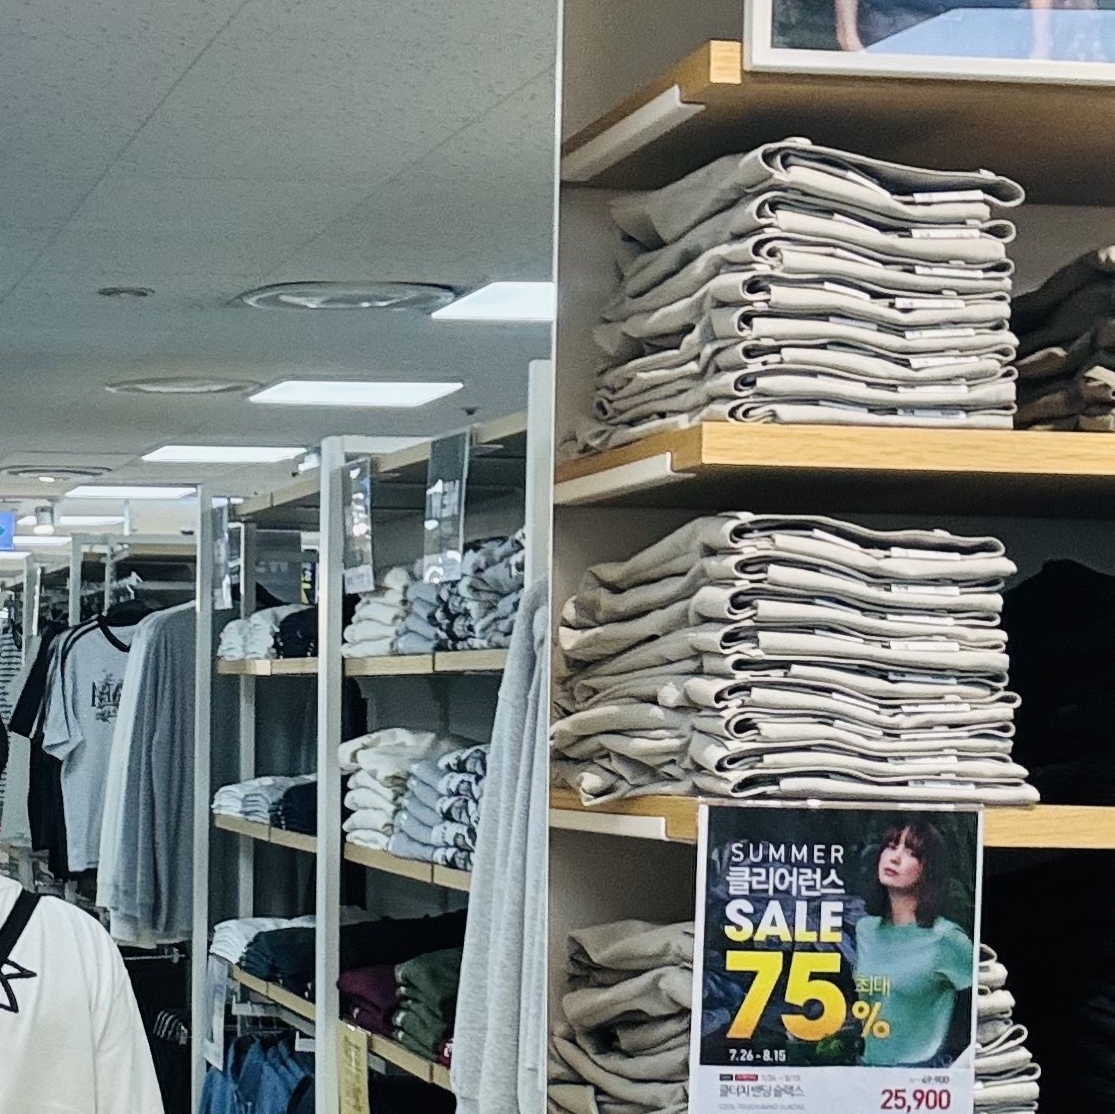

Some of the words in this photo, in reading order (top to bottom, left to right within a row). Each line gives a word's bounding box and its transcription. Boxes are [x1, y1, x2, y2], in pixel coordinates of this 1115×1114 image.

[731, 842, 844, 864] SUMMER
[725, 866, 846, 896] 클리어런스
[724, 899, 844, 943] SALE
[855, 974, 890, 996] 최대
[880, 1089, 951, 1114] 25,900
